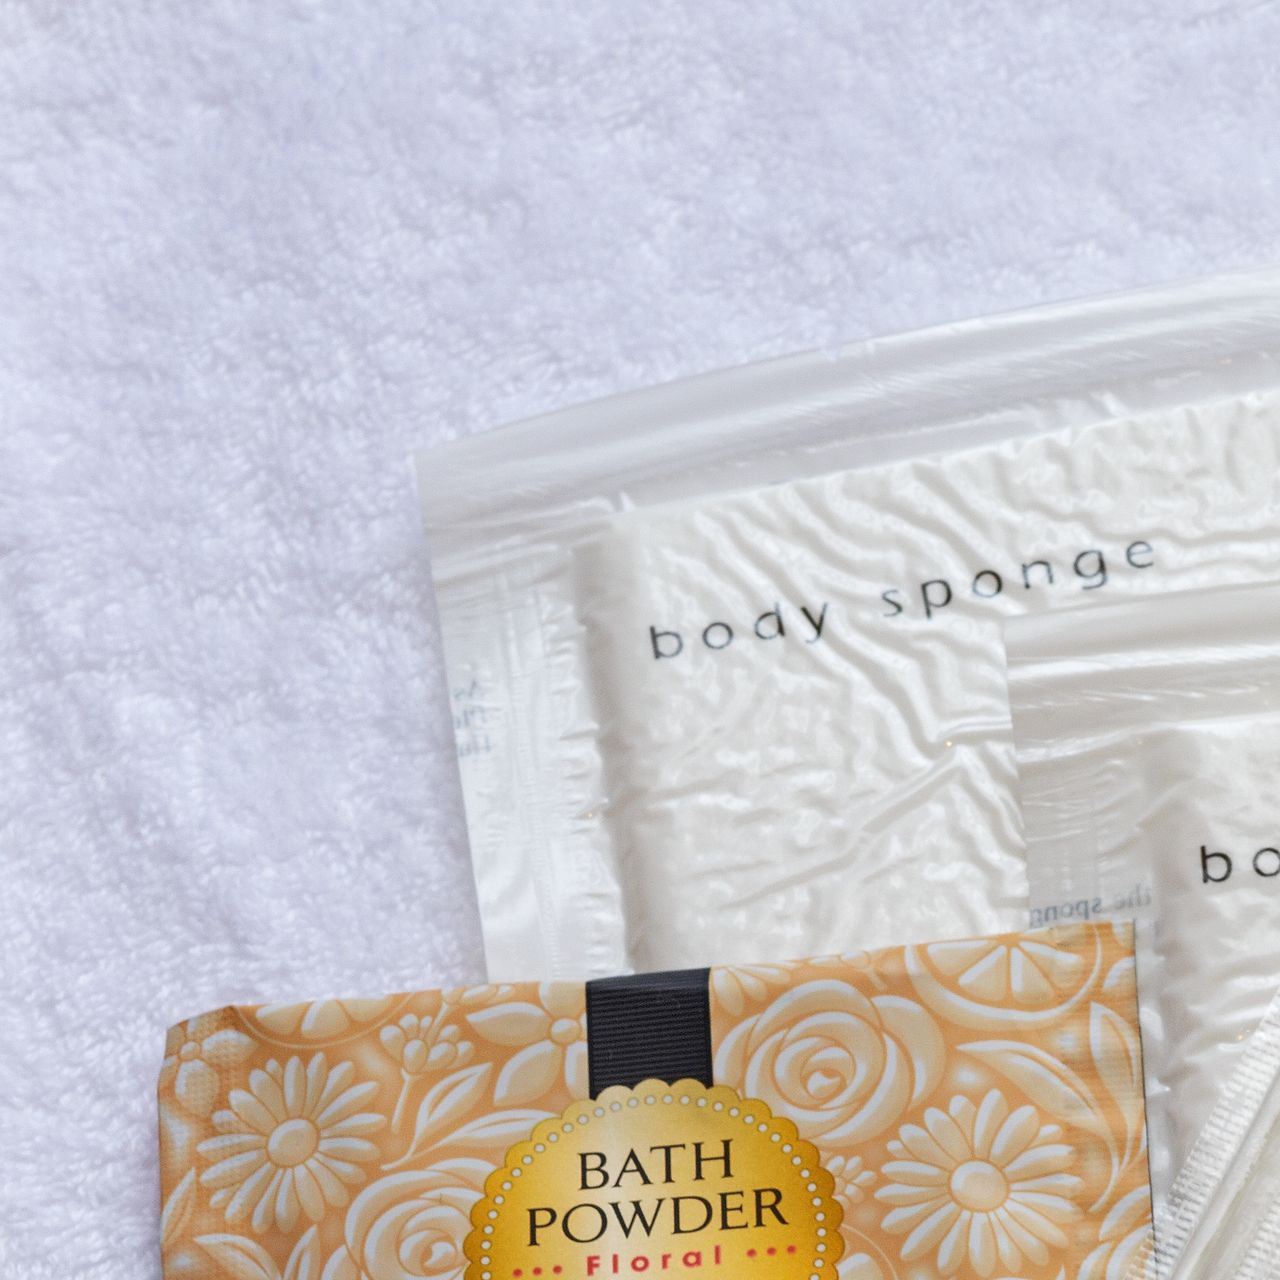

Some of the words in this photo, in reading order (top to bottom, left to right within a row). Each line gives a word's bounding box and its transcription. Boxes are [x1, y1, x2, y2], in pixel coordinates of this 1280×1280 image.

[649, 601, 829, 661] body
[881, 537, 1155, 618] sponge
[577, 1138, 734, 1191] BATH
[526, 1187, 789, 1247] POWDER
[586, 1245, 722, 1277] Floral
